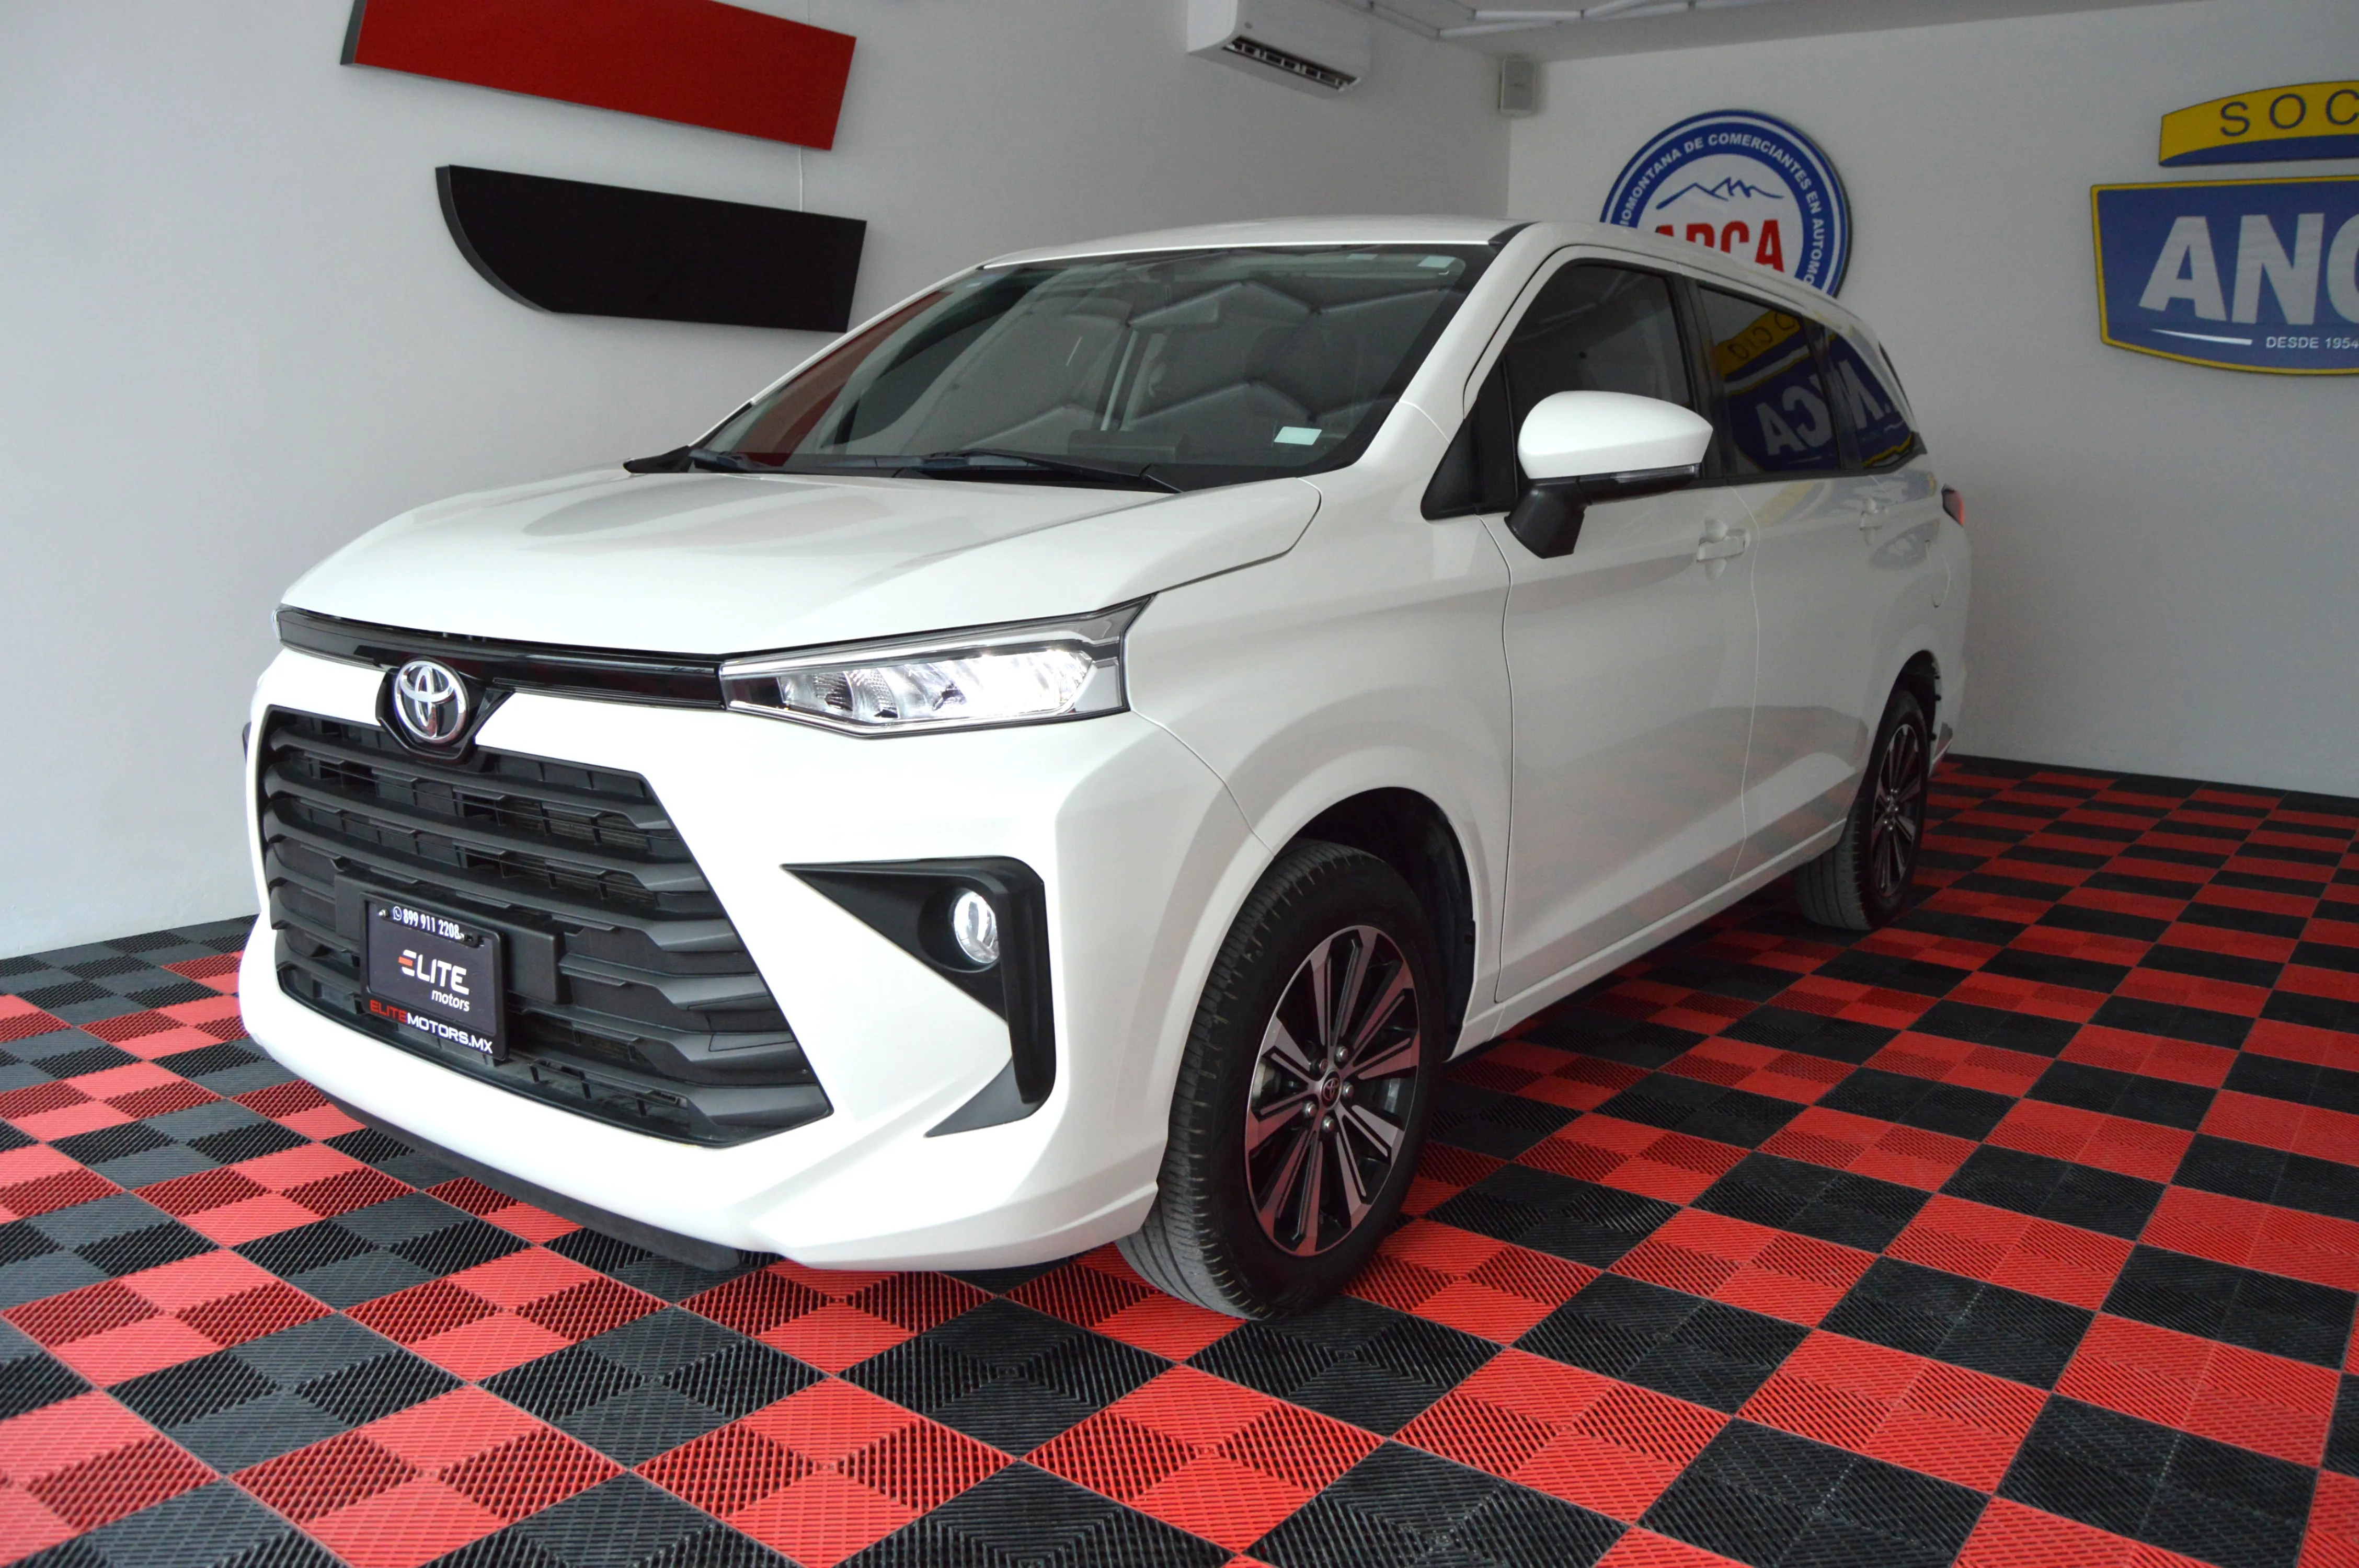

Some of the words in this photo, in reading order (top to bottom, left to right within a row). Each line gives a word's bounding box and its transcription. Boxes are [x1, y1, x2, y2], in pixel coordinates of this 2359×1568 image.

[2220, 89, 2359, 137] SOC
[1684, 136, 1704, 153] DE
[1708, 132, 1812, 190] COMERCIANTES
[1805, 190, 1823, 214] EN
[2265, 336, 2320, 349] DESDE
[2325, 337, 2359, 349] 1954
[403, 908, 419, 927] 899
[420, 914, 436, 932] 911
[438, 919, 460, 939] 2208
[398, 949, 469, 995] ELITE
[431, 990, 470, 1012] motors
[370, 1000, 493, 1054] ELITEMOTORS.MX
